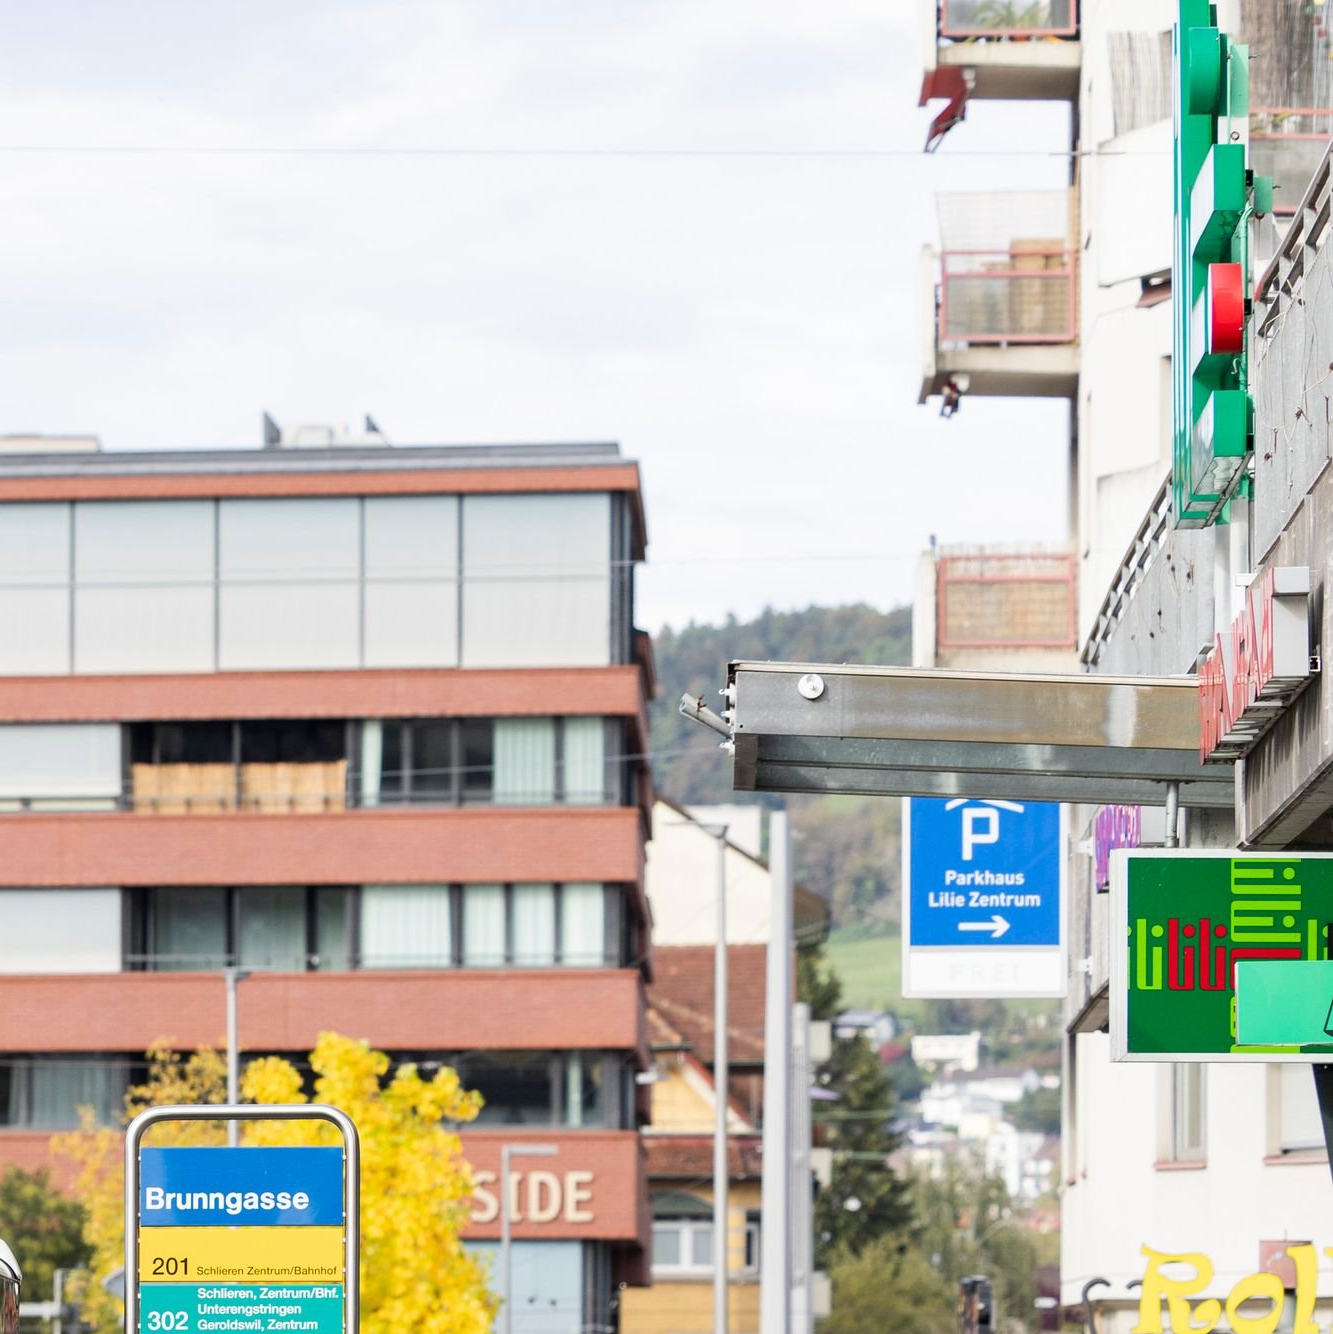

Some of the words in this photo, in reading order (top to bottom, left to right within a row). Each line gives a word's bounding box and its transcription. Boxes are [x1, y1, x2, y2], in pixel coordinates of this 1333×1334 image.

[962, 807, 1000, 861] P
[944, 870, 1025, 886] Parkhaus
[928, 891, 966, 908] Lilie
[968, 891, 1042, 908] Zentrum
[145, 1187, 310, 1215] Brunngasse
[470, 1171, 595, 1223] SIDE
[152, 1257, 189, 1276] 201
[196, 1265, 244, 1276] Schlieren
[247, 1265, 337, 1277] Zentrum/Bahnhof
[197, 1287, 257, 1300] Schlieren,
[259, 1287, 339, 1300] Zentrum/Bhf.
[197, 1303, 302, 1316] Unterengstringen
[147, 1311, 189, 1331] 302
[197, 1319, 265, 1332] Geroldswil,
[267, 1319, 318, 1331] Zentrum
